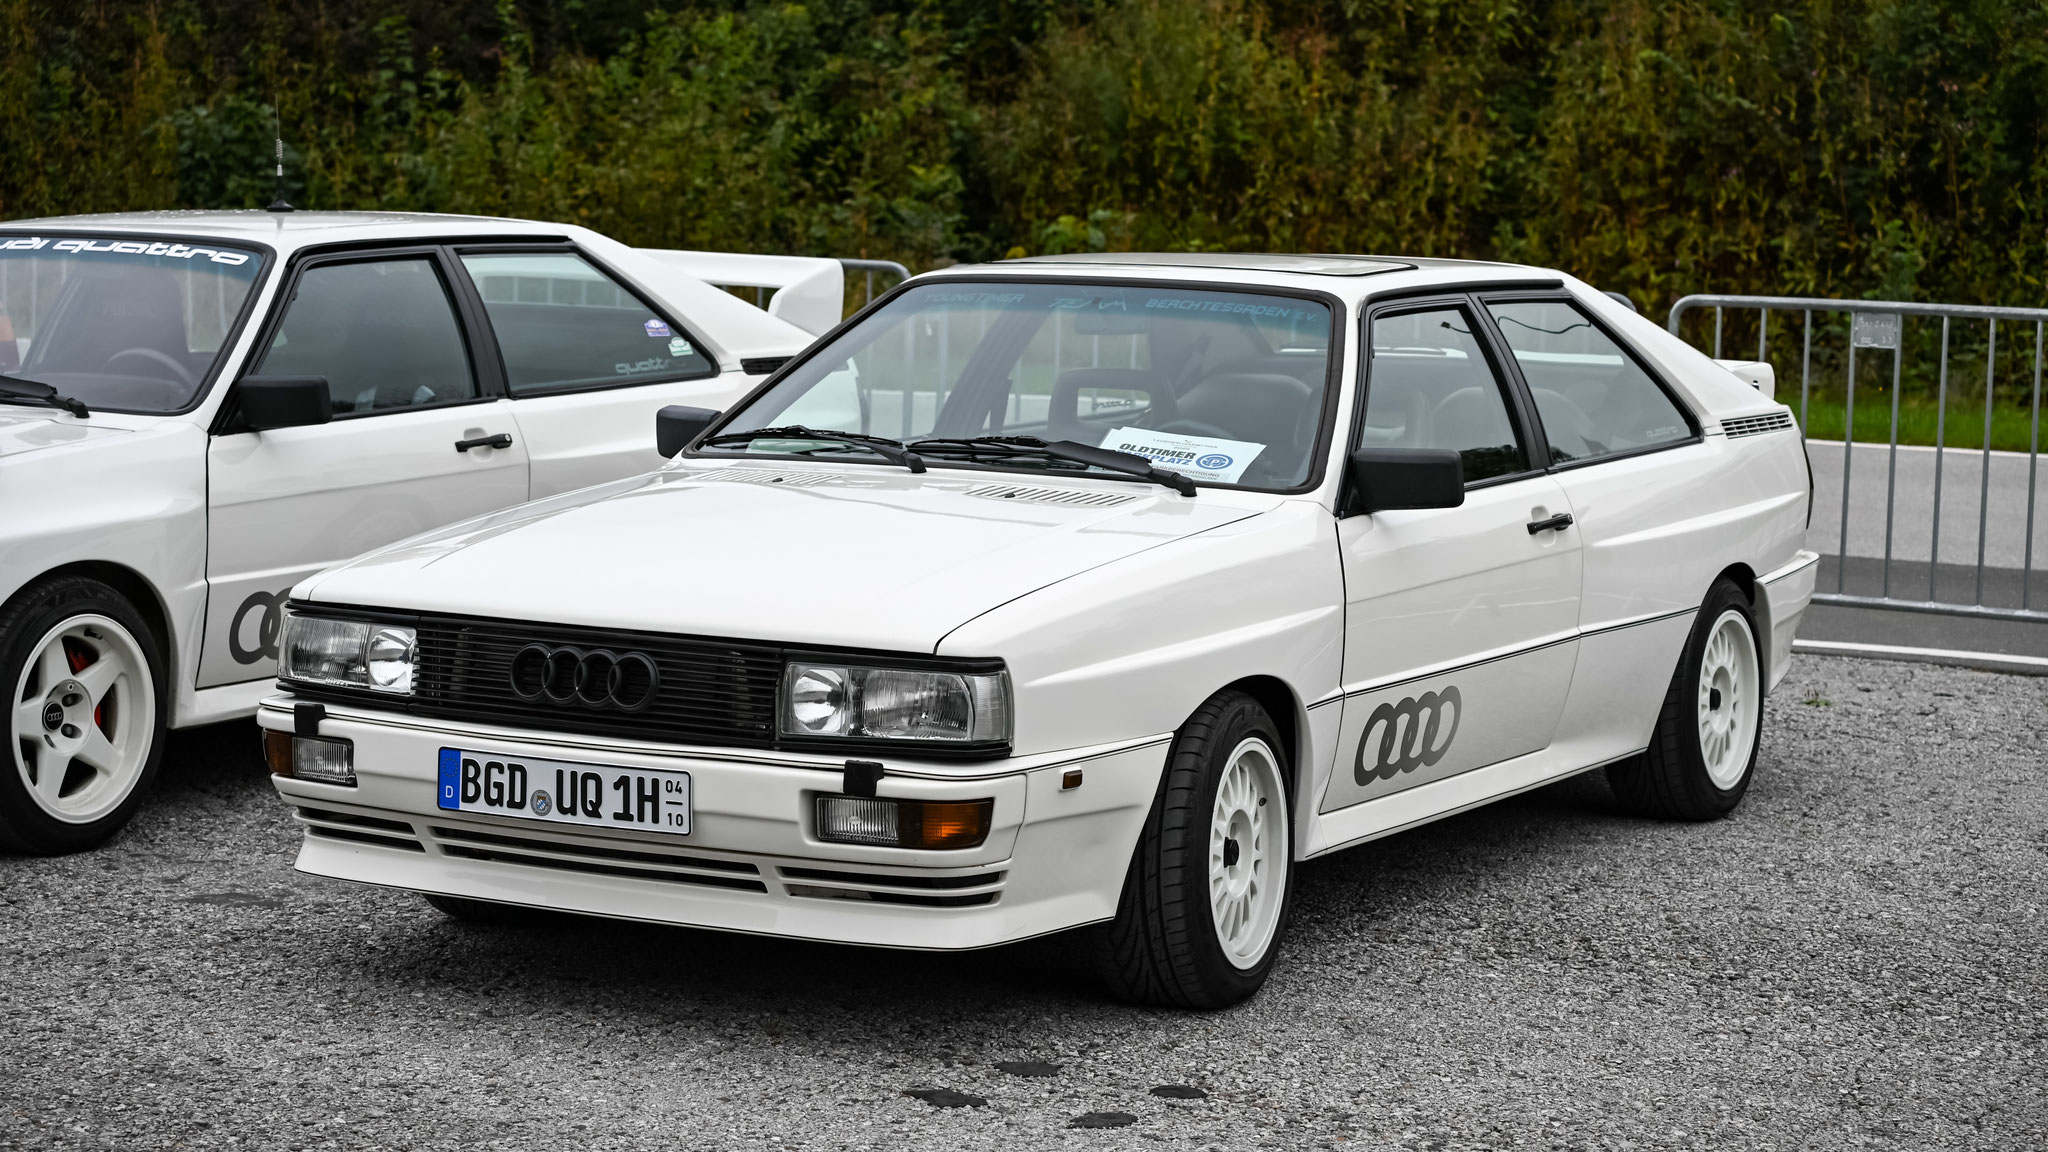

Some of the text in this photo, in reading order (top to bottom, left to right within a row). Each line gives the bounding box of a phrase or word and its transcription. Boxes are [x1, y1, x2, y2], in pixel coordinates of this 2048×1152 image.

[53, 239, 250, 266] quattro
[1145, 299, 1290, 317] BERCHTESGADEN
[1116, 450, 1193, 465] KPLATZ
[1119, 443, 1197, 459] OLDTIMER
[445, 785, 454, 798] D
[461, 758, 527, 810] BGD
[556, 769, 602, 819] UQ
[612, 775, 660, 824] 1H
[665, 780, 683, 794] 04
[667, 812, 684, 827] 10
